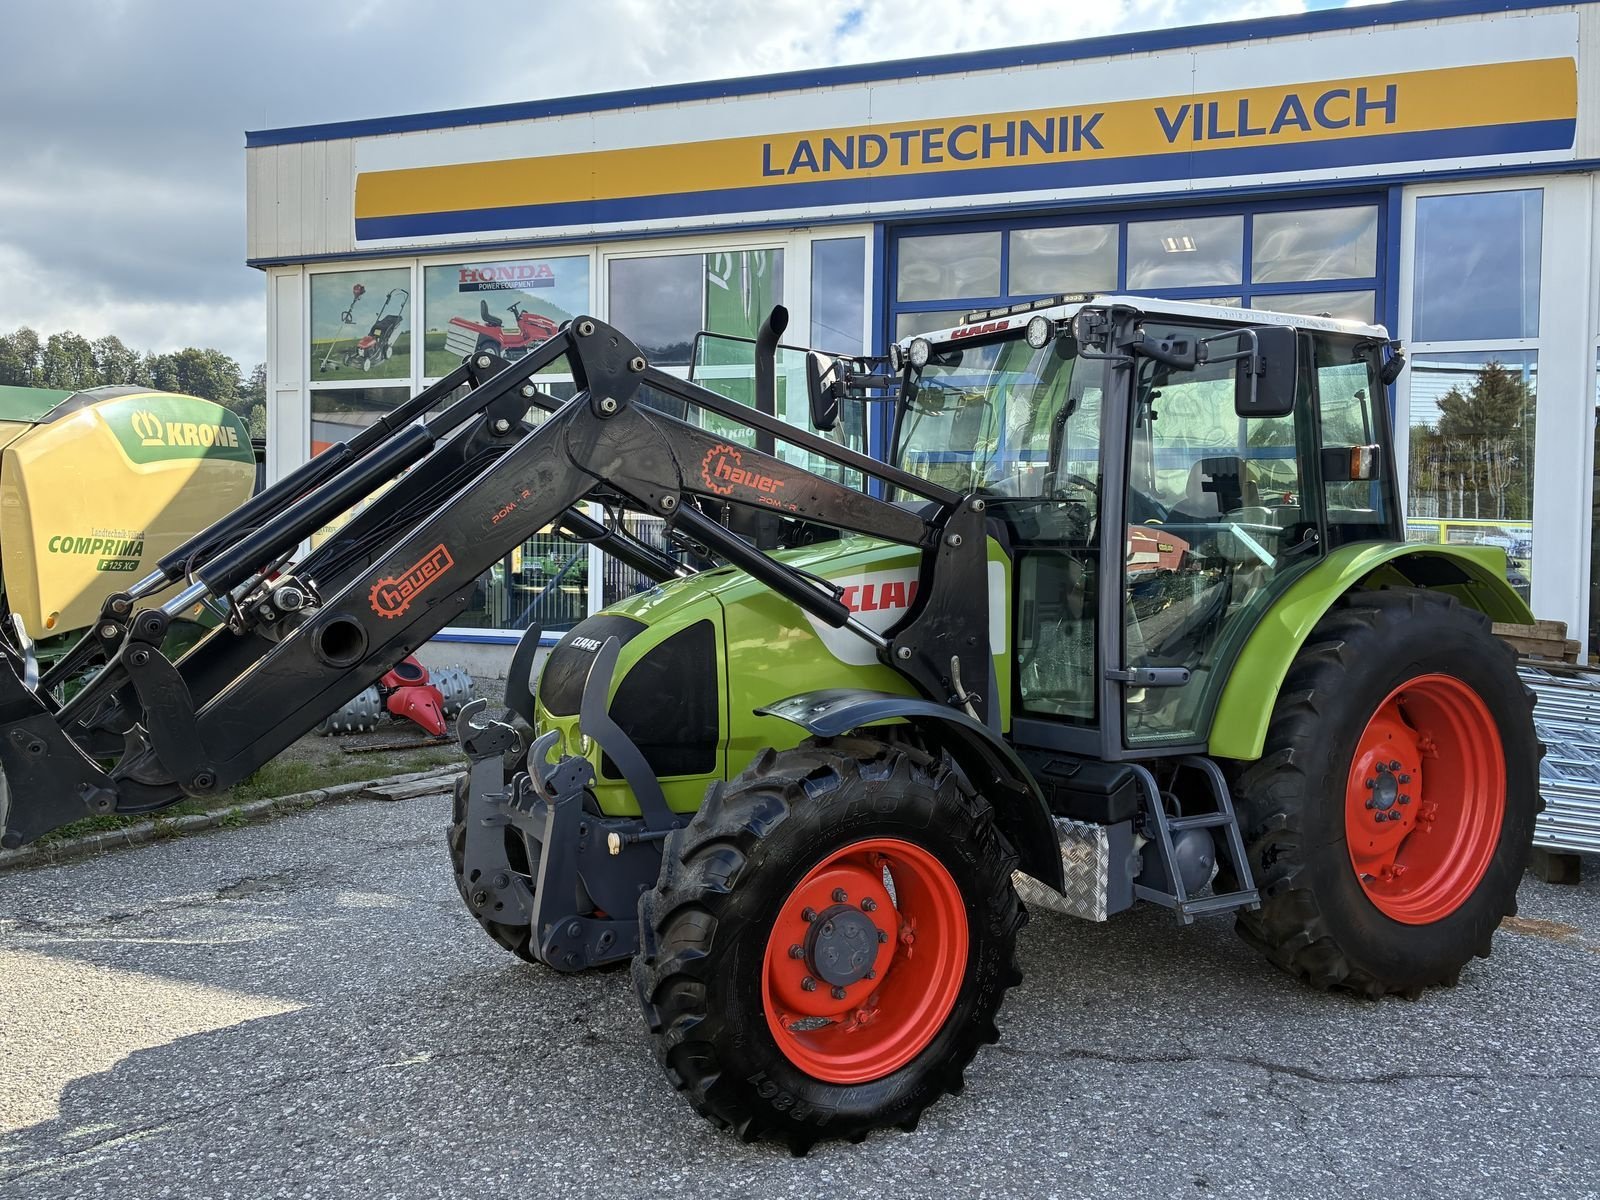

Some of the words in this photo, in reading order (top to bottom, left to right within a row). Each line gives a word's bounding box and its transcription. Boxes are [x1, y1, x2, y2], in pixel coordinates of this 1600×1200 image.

[762, 112, 1105, 176] LANDTECHNIK
[1154, 84, 1397, 144] VILLACH
[459, 264, 555, 283] HONDA
[478, 282, 500, 290] POWER
[501, 280, 534, 289] EQUIPMENT
[950, 320, 1010, 339] CLAAS
[166, 422, 239, 448] KRONE
[714, 456, 785, 494] hauer
[48, 535, 144, 557] COMPRIMA
[109, 561, 122, 570] 125
[123, 562, 135, 570] XC
[382, 552, 442, 609] hauer
[570, 636, 602, 651] CLAAS
